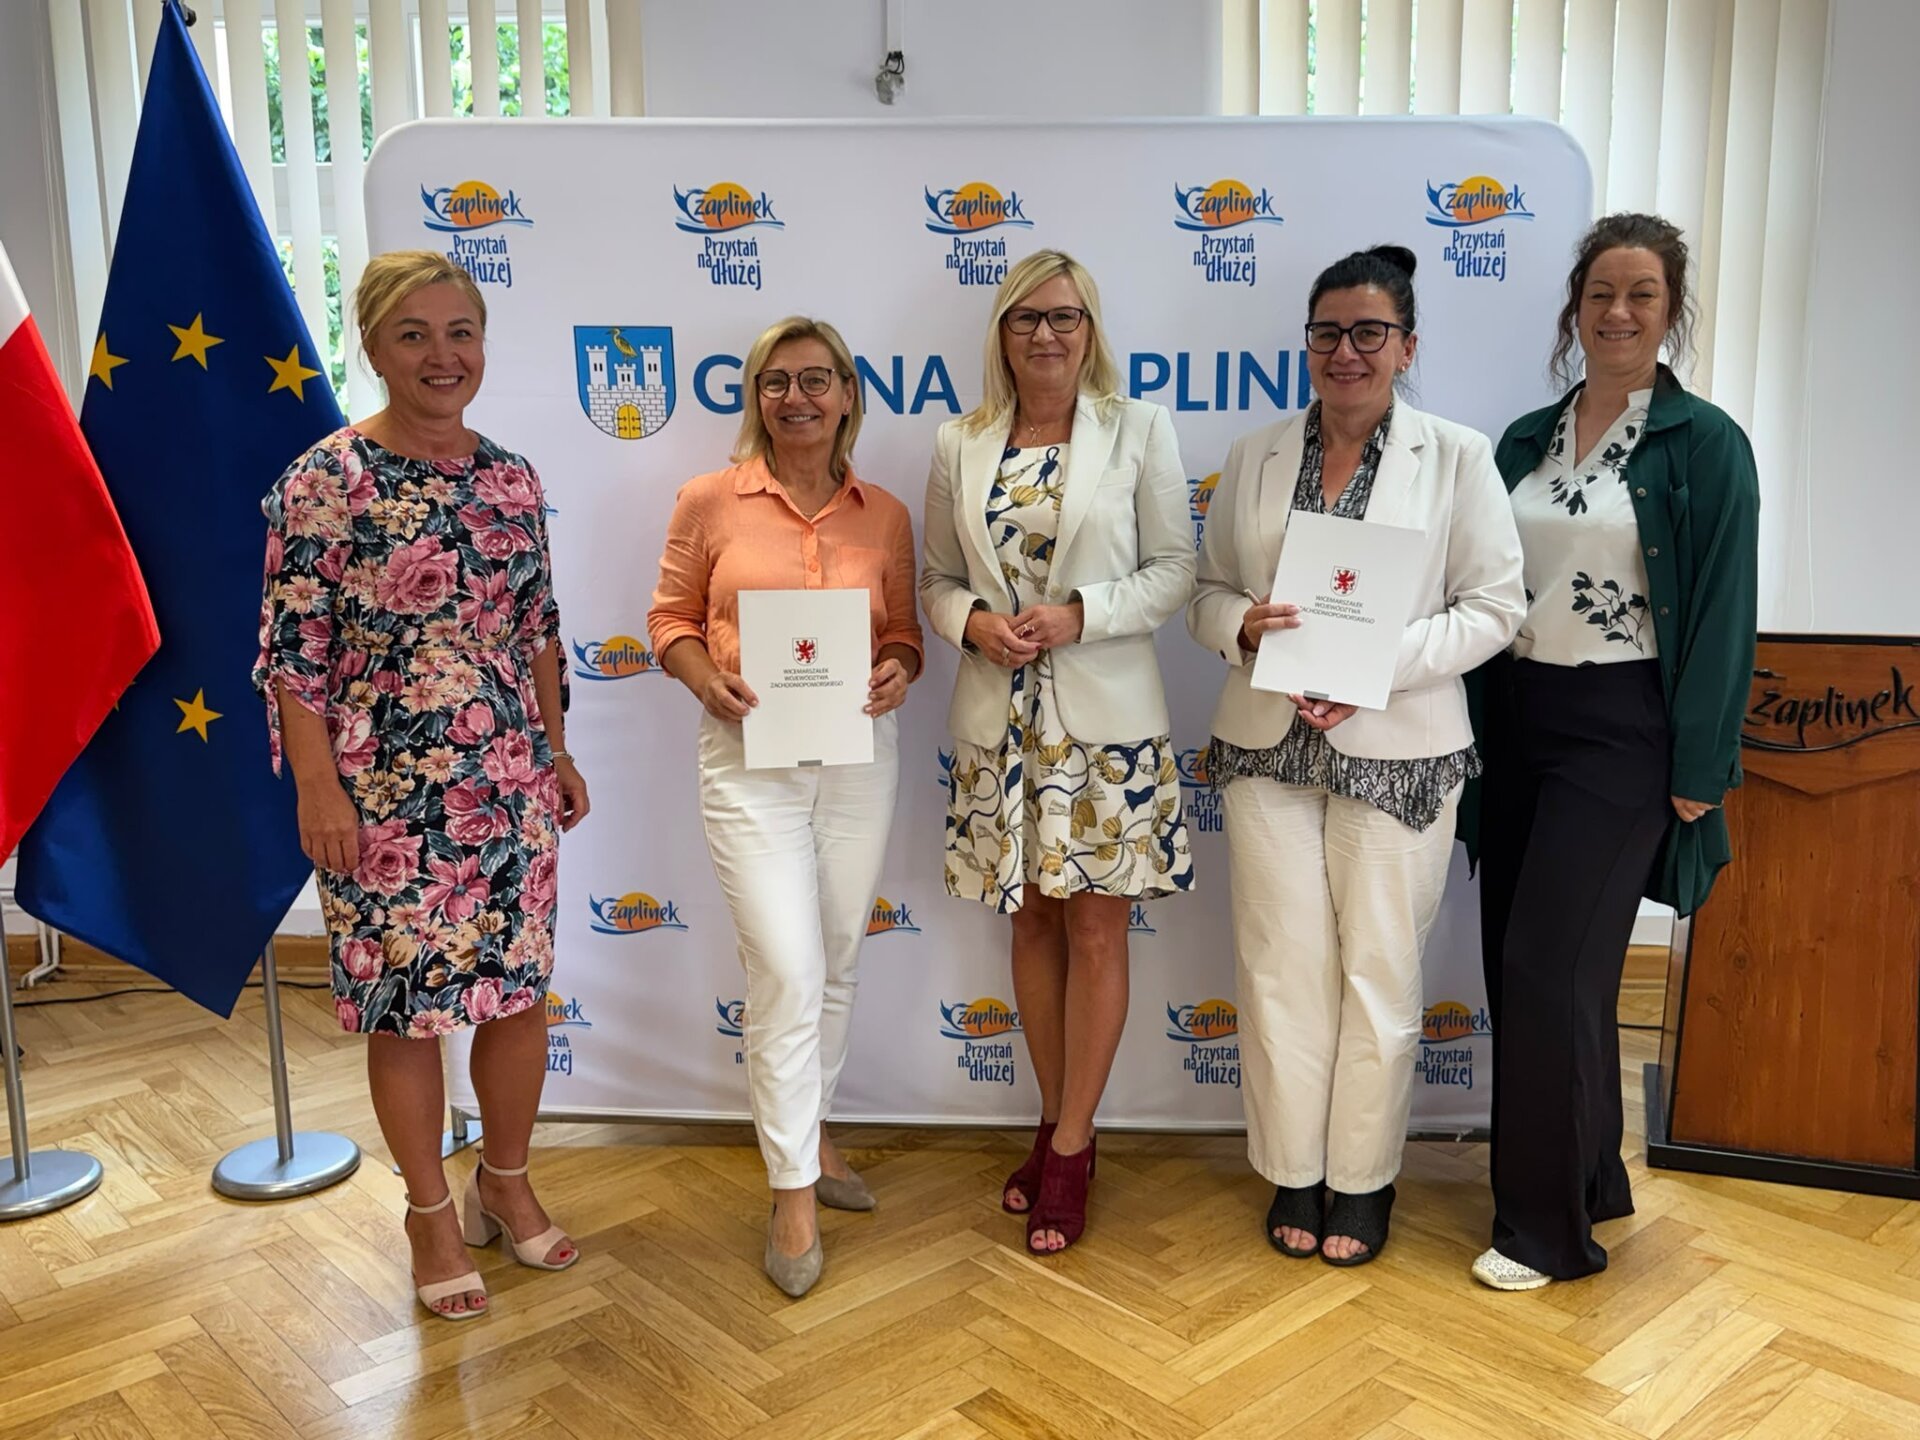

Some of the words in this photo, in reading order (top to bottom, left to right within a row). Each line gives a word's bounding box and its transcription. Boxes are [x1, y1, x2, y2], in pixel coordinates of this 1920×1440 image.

[453, 234, 507, 259] Przystań
[705, 236, 758, 261] Przystań
[953, 237, 1006, 261] Przystań
[1202, 233, 1254, 258] Przystań
[1453, 228, 1505, 254] Przystań
[697, 253, 712, 268] na
[711, 258, 761, 291] dłużej
[946, 254, 960, 269] na
[1193, 251, 1207, 266] na
[1206, 255, 1256, 287] dłużej
[1443, 246, 1457, 261] na
[1455, 251, 1506, 282] dłużej
[693, 354, 963, 415] GNA
[573, 637, 659, 674] Czapline
[940, 999, 1022, 1034] Czapline
[1167, 1001, 1238, 1036] Czaplin
[965, 1041, 1012, 1062] Przystań
[1191, 1043, 1239, 1064] Przystań
[1424, 1046, 1472, 1066] Przystań
[957, 1055, 970, 1068] na
[969, 1059, 1014, 1086] dłużej
[1183, 1058, 1196, 1070] na
[1195, 1061, 1241, 1088] dłużej
[1425, 1063, 1473, 1090] dłużej
